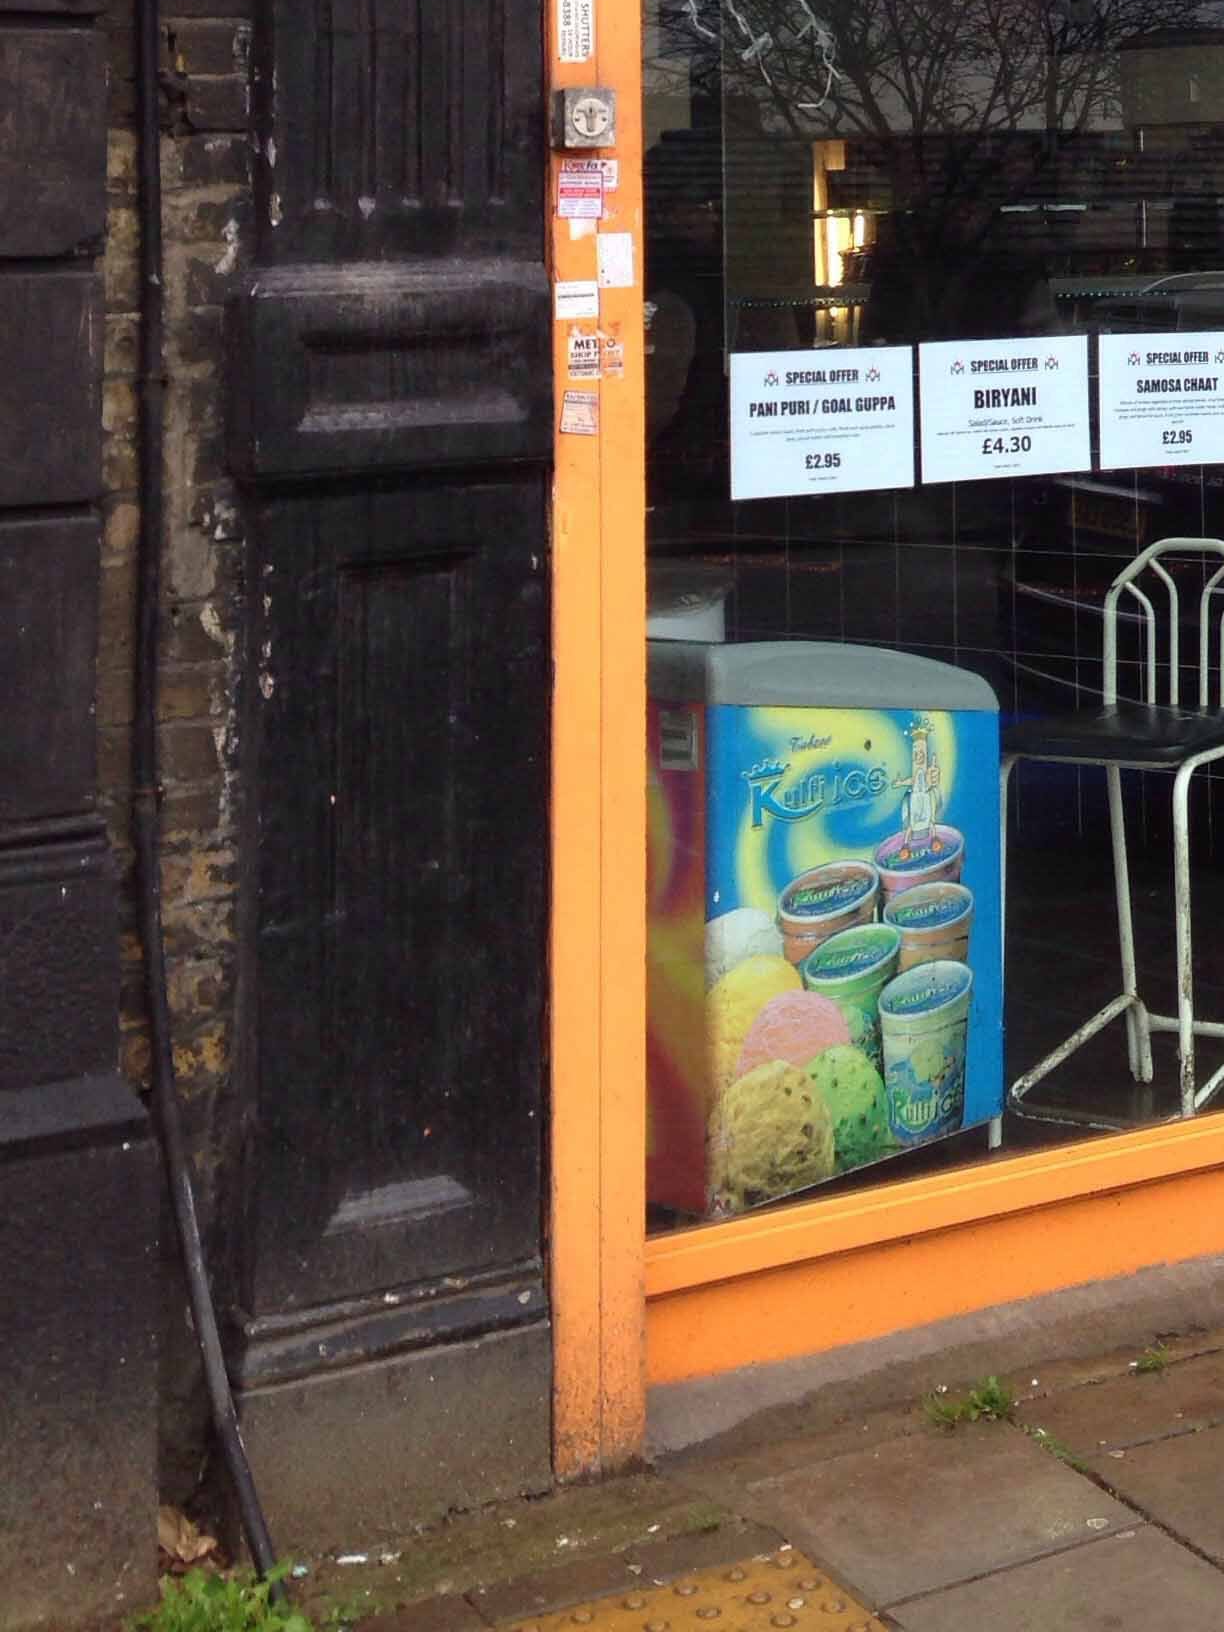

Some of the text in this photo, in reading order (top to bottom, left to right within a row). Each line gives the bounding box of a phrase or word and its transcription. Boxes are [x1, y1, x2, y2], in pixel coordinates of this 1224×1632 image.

[970, 357, 1039, 372] SPECIAL OFFER
[1146, 351, 1209, 364] SPECIAL OFFER
[785, 369, 859, 385] SPECIAL OFFER
[1136, 377, 1219, 394] SAMOSA CHAAT
[973, 386, 1037, 409] BIRYANI
[749, 402, 778, 418] PANI
[781, 400, 810, 416] PURI
[821, 398, 853, 414] GOAL
[855, 396, 896, 412] GUPPA
[981, 435, 1032, 455] £4.30
[1162, 429, 1193, 445] £2.95
[805, 453, 841, 470] £2.95
